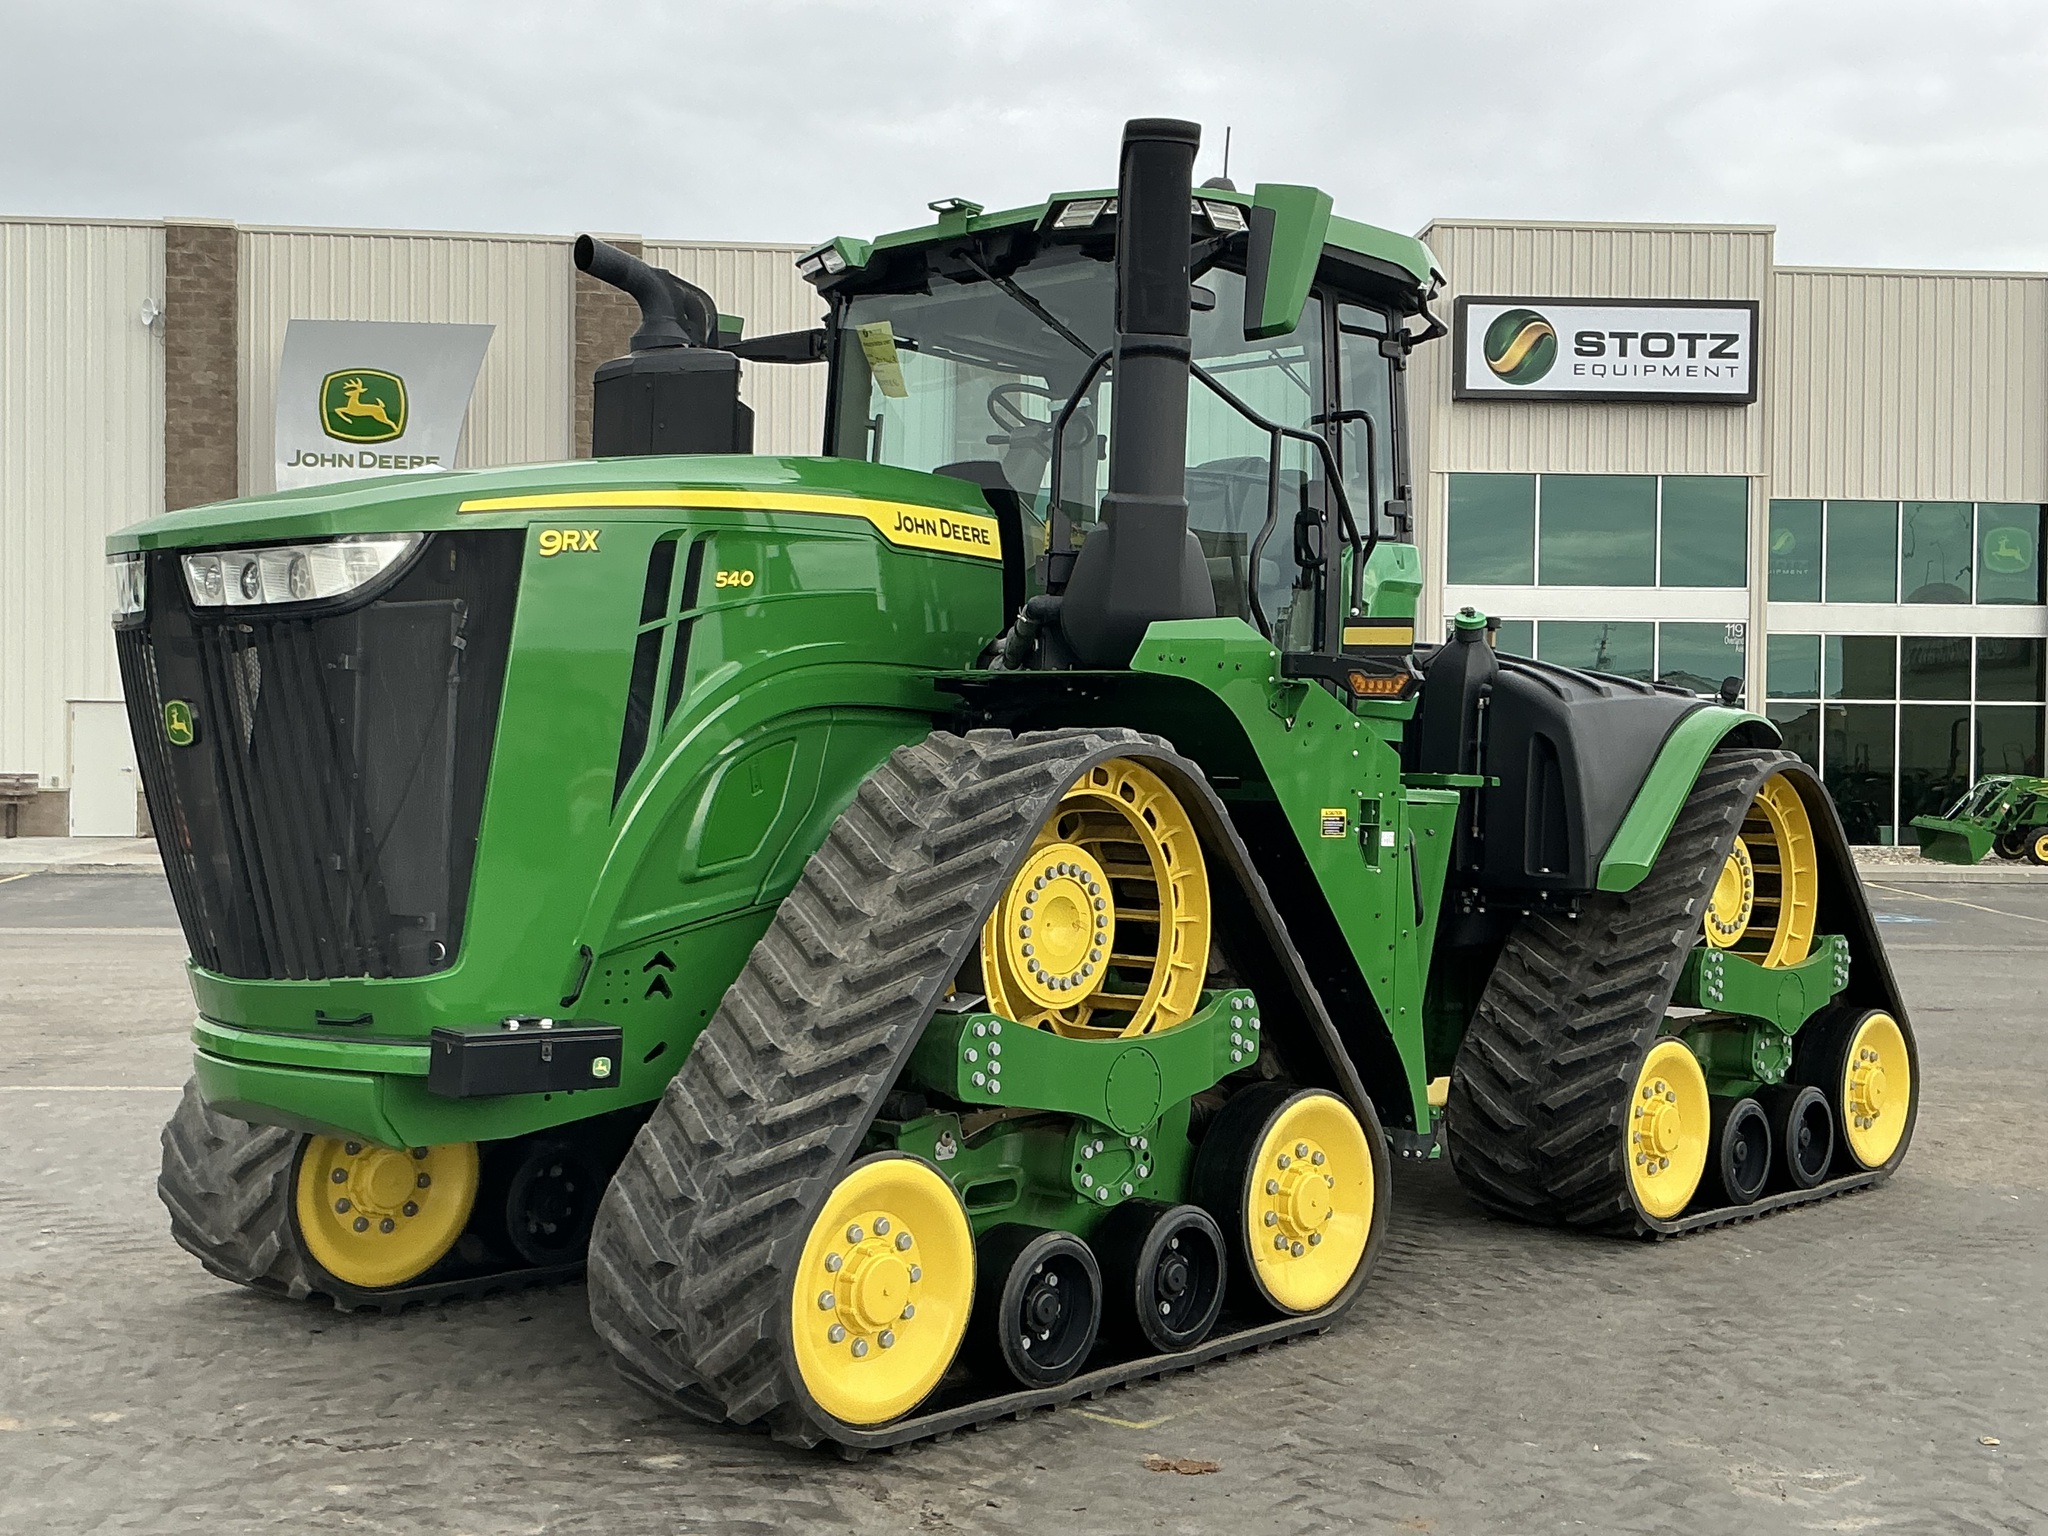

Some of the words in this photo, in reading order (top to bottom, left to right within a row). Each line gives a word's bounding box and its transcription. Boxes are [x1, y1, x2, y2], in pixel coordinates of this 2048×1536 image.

[1573, 331, 1740, 360] STOTZ
[1573, 363, 1740, 379] EQUIPMENT
[287, 449, 354, 468] JOHN
[893, 511, 938, 537] JOHN
[939, 518, 991, 546] DEERE
[539, 529, 601, 558] 9RX
[714, 570, 755, 588] 540
[1725, 623, 1744, 637] 119
